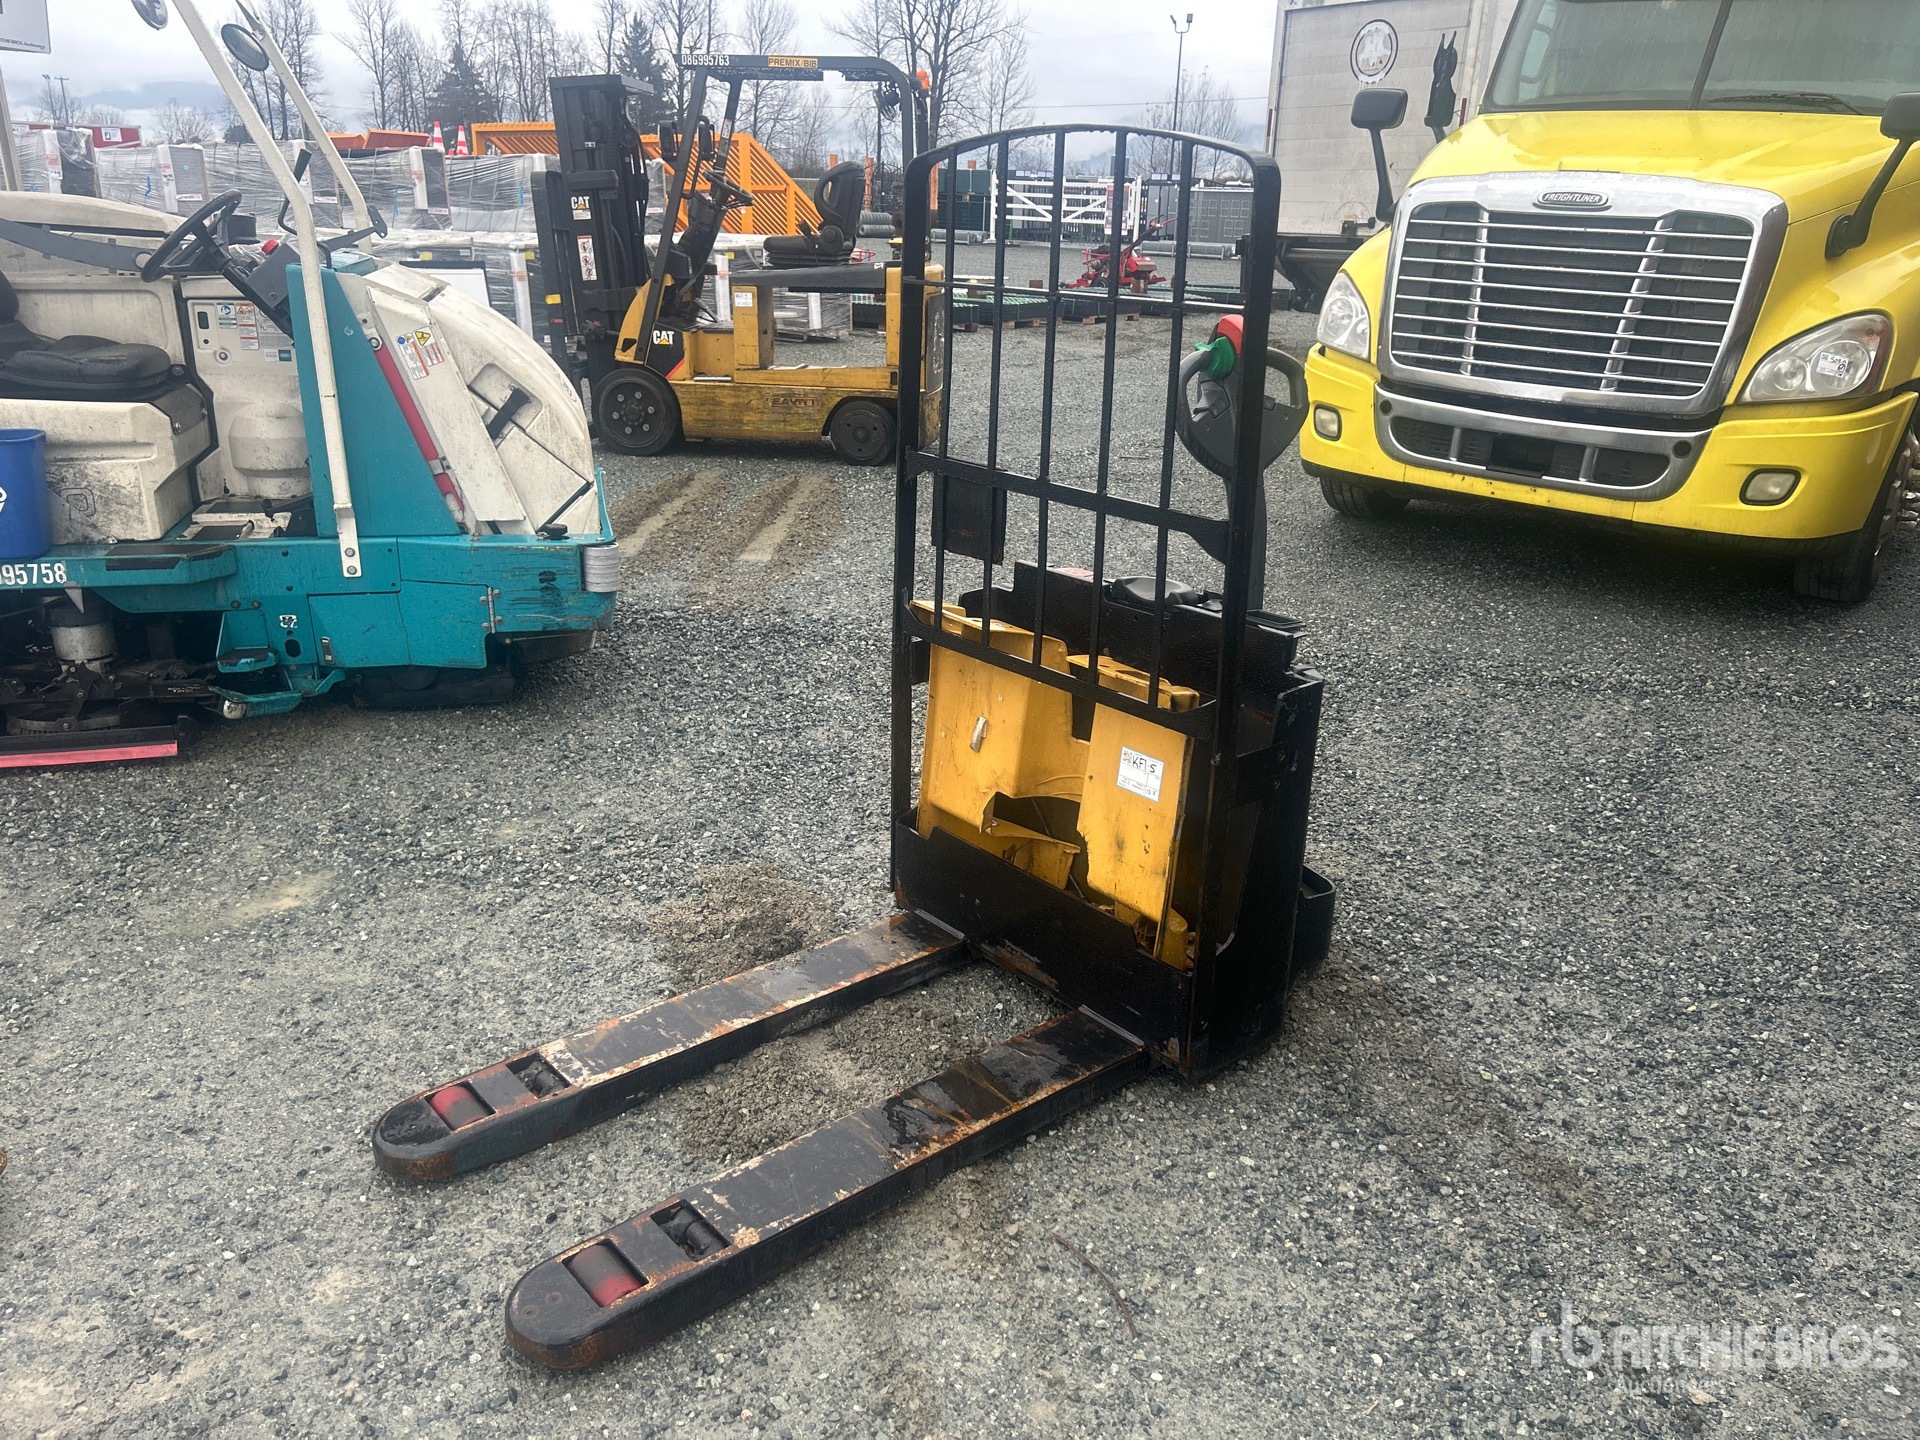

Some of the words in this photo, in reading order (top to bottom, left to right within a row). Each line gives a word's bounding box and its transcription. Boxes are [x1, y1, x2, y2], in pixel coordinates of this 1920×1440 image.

[681, 54, 730, 66] 08G995763
[767, 58, 818, 68] PREMIX/BIB
[571, 196, 590, 210] CAT
[1543, 193, 1601, 203] FREIGHTLINER
[653, 330, 675, 345] CAT
[0, 562, 67, 586] 95758
